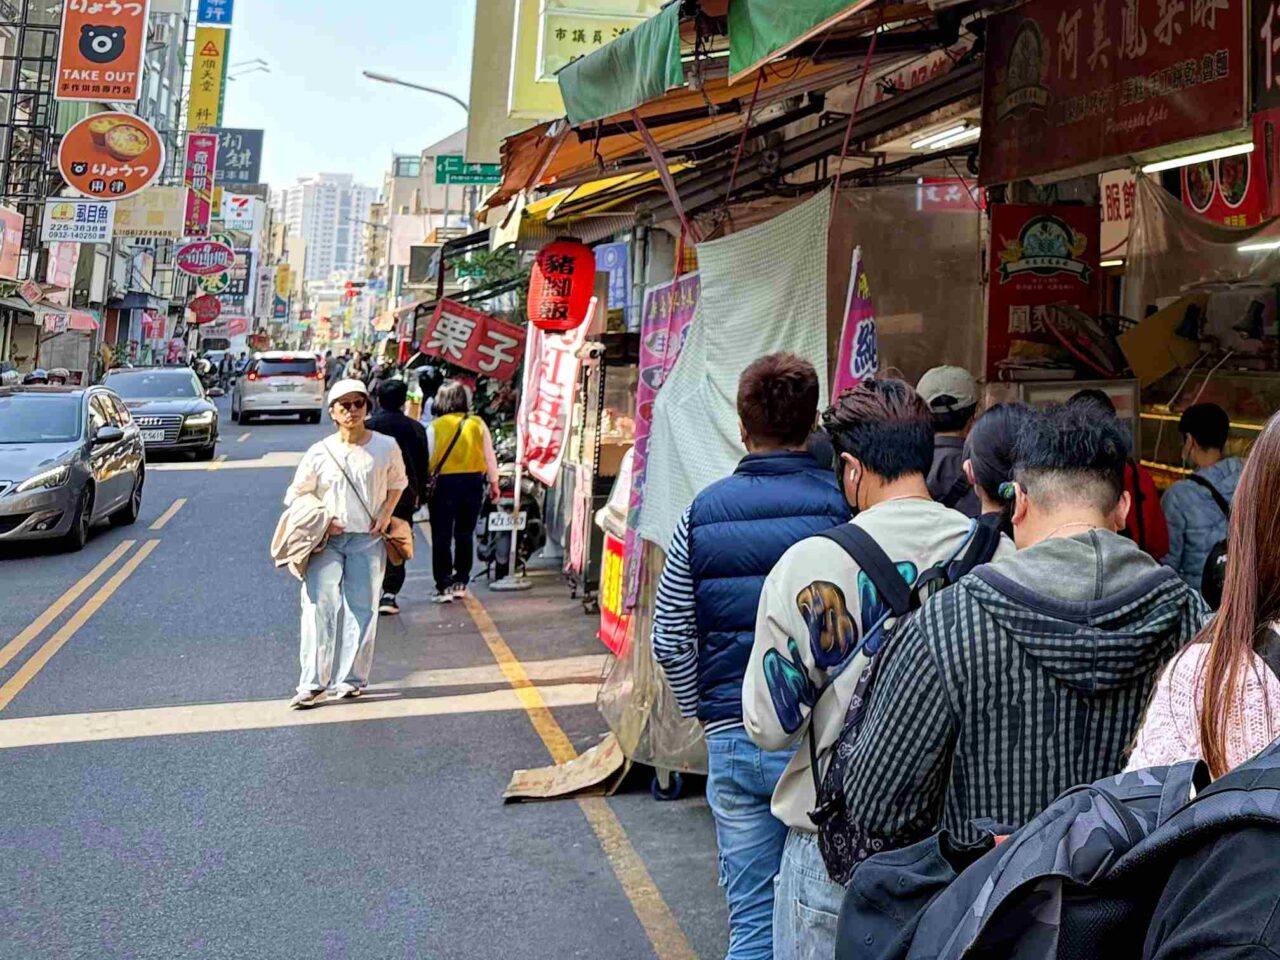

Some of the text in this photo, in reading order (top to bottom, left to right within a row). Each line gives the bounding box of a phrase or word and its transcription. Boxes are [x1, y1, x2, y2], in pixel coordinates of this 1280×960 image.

[62, 69, 136, 83] TAKE OUT
[91, 164, 149, 177] りょうつ
[426, 311, 521, 372] 栗子
